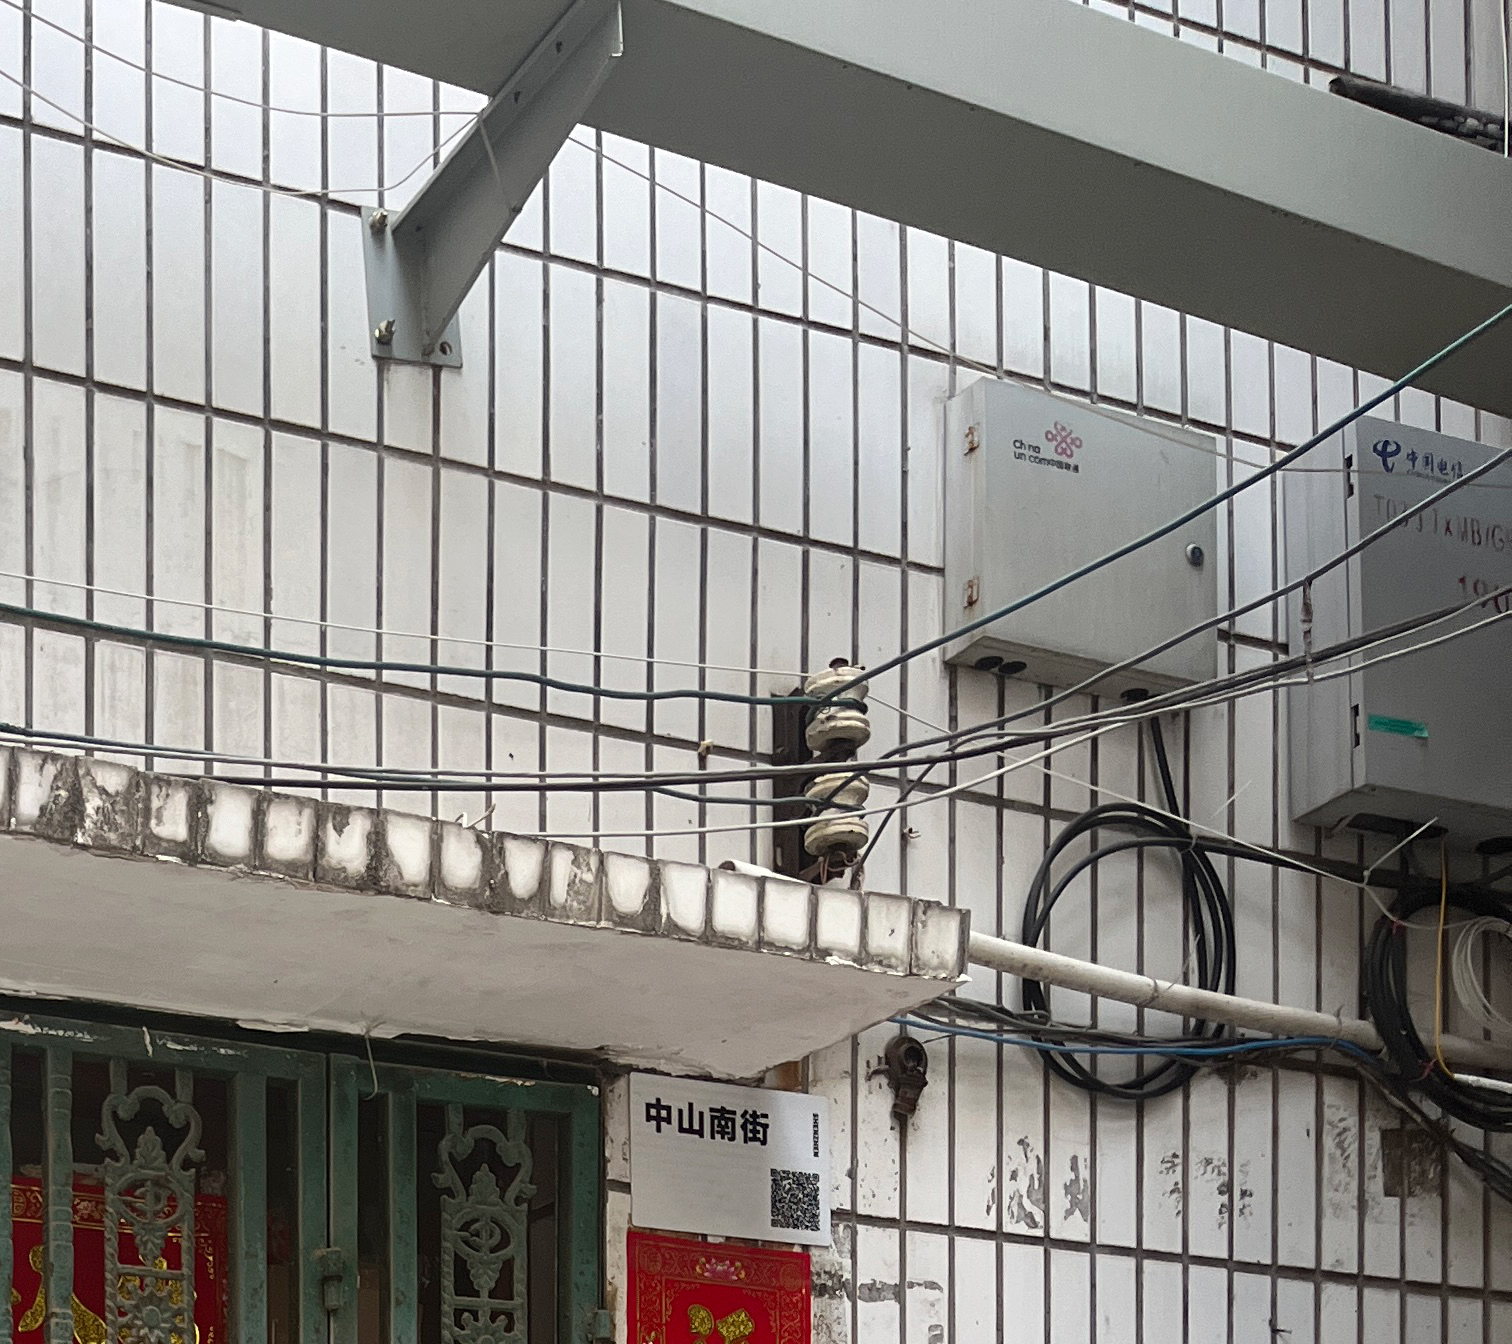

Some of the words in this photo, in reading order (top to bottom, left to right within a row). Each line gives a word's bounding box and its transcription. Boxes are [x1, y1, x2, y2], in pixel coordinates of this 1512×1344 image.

[1013, 439, 1041, 454] Chna
[645, 1098, 769, 1146] 中山南街
